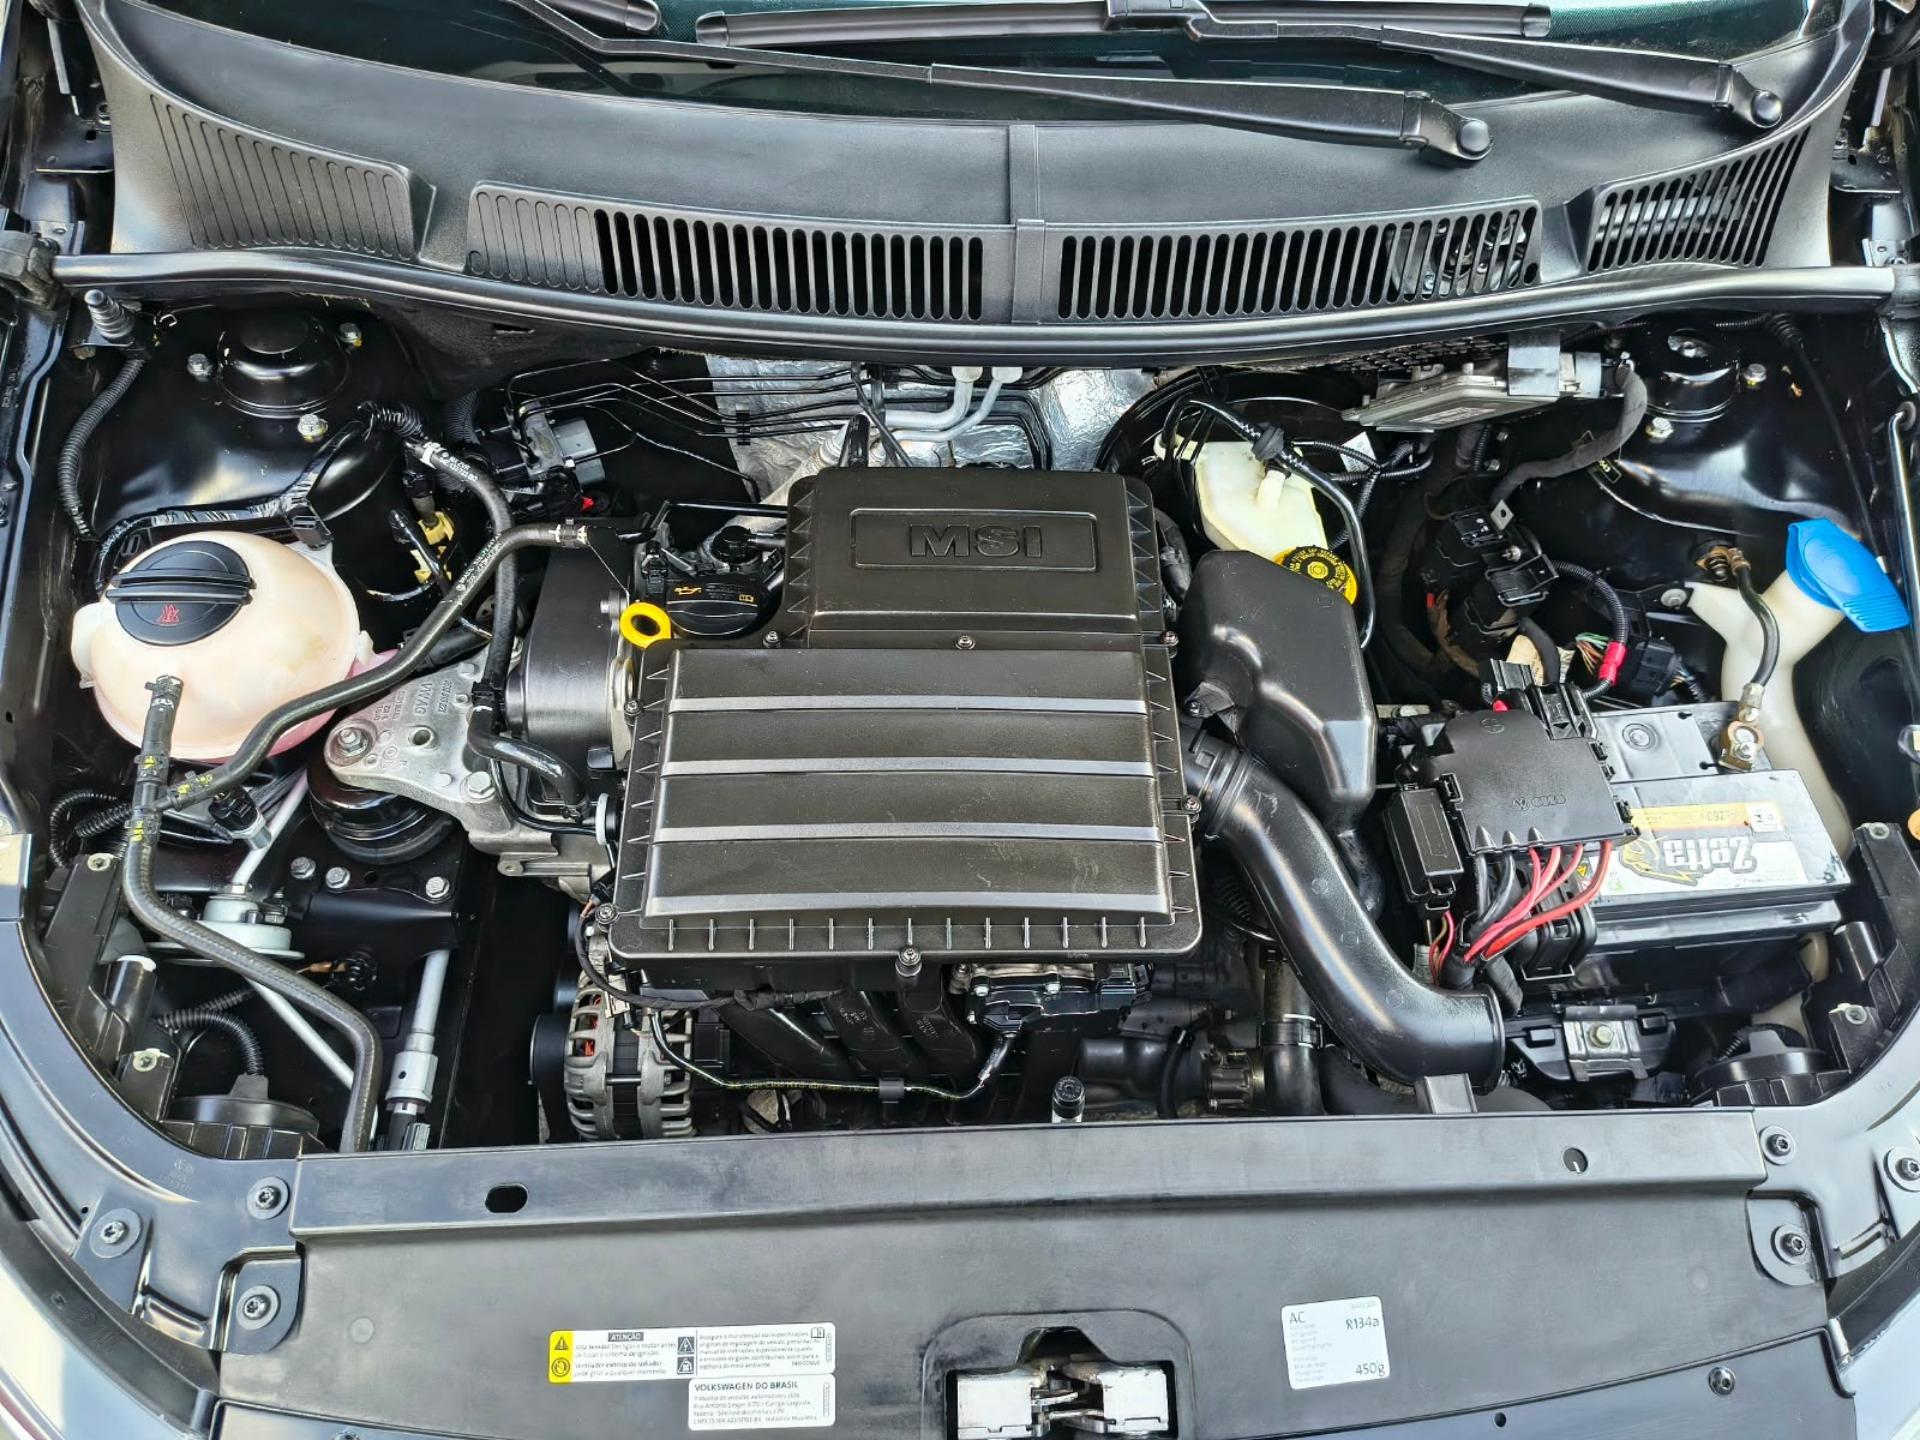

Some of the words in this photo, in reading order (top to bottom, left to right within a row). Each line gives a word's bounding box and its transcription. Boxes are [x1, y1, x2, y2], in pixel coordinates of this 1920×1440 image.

[908, 522, 1042, 558] MSI
[1662, 835, 1755, 872] Zetta
[1289, 1311, 1306, 1324] AC
[1345, 1316, 1380, 1330] R134a
[694, 1383, 754, 1391] VOLKSWAGEN
[755, 1382, 768, 1390] DO
[770, 1380, 798, 1389] BRASIL
